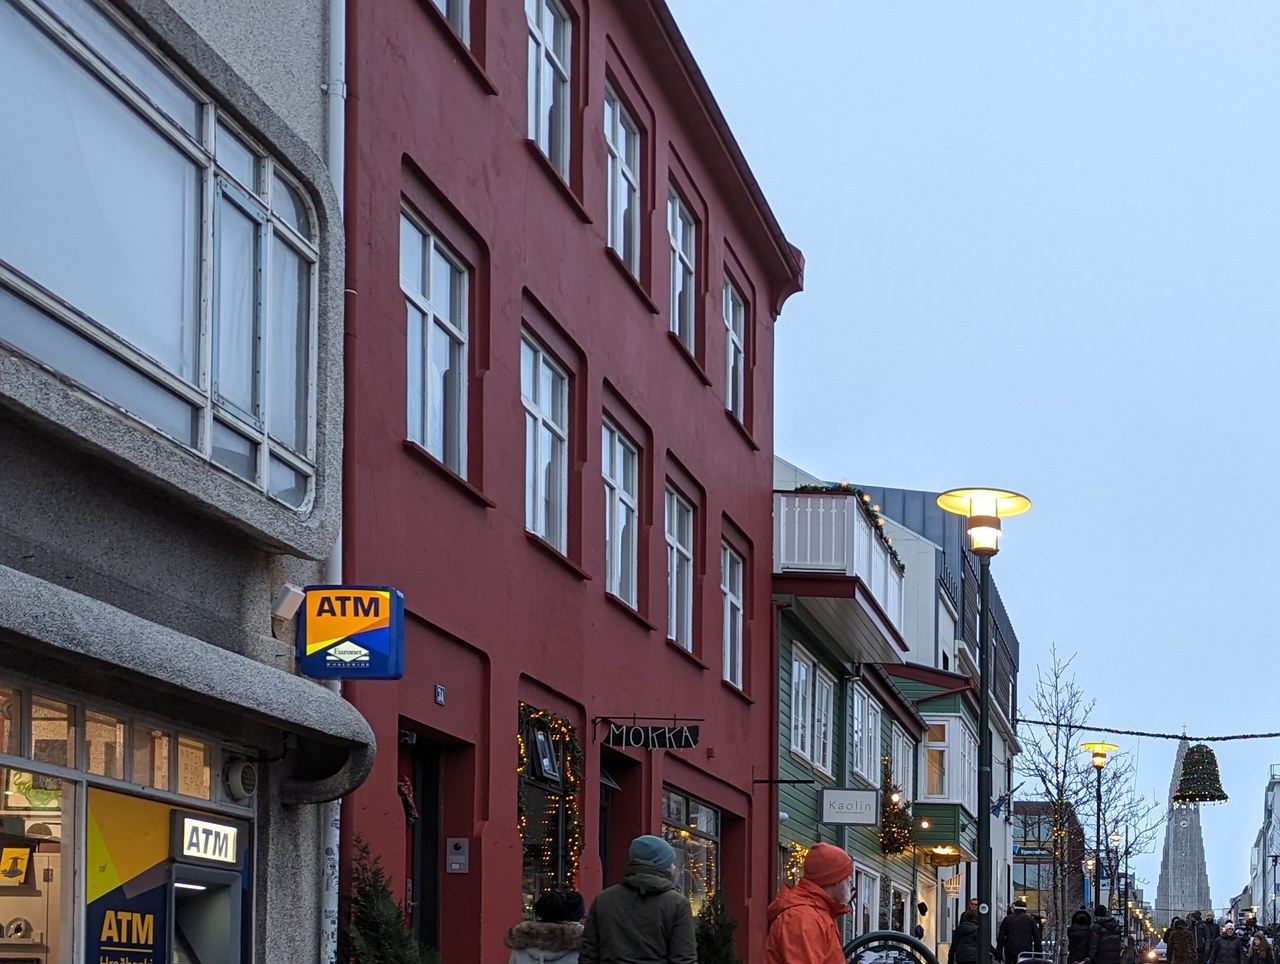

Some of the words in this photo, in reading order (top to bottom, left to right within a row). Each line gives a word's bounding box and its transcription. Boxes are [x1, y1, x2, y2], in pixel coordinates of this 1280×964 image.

[316, 596, 380, 617] ATM
[609, 725, 697, 750] MOKKA
[829, 801, 871, 811] Kaolin
[186, 826, 229, 859] ATM
[100, 909, 154, 945] ATM
